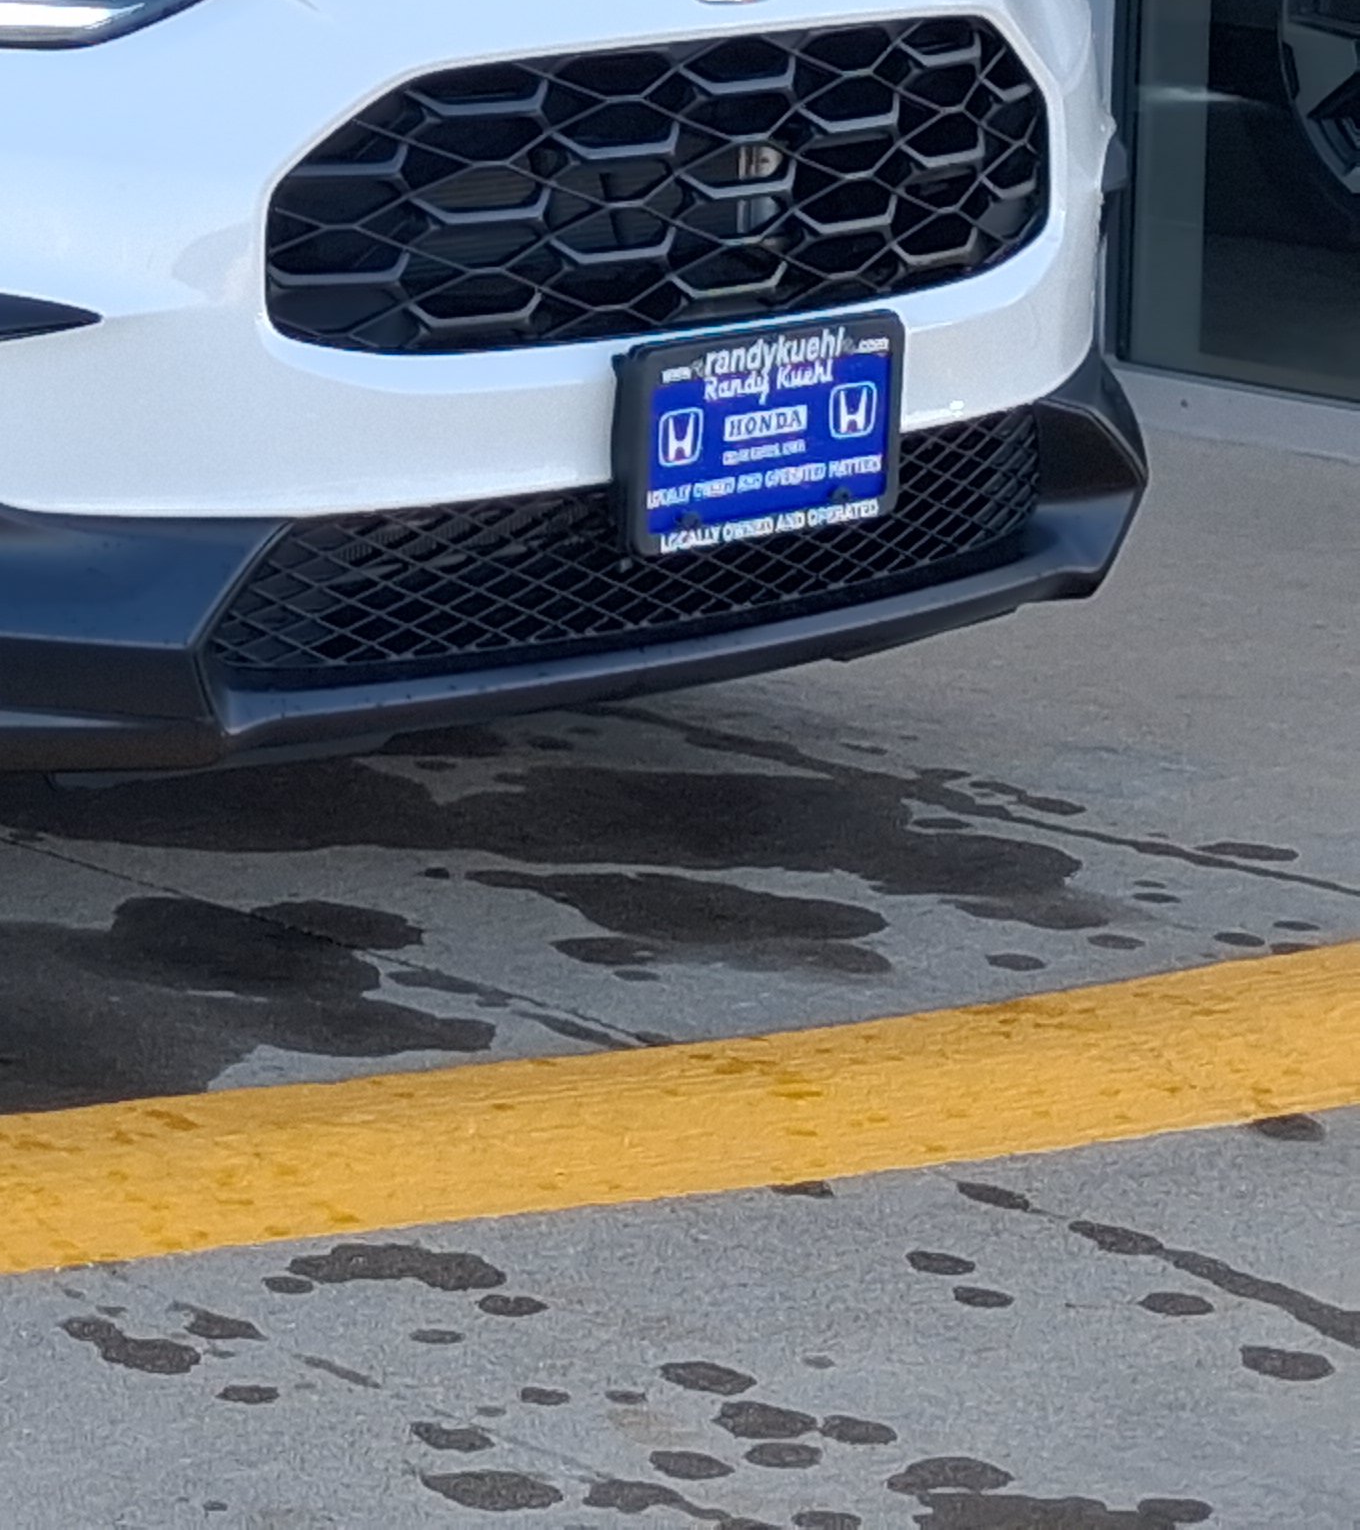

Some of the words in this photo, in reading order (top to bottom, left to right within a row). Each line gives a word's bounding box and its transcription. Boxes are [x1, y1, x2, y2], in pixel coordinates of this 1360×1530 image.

[704, 327, 846, 378] randykuehl
[702, 374, 771, 405] Randy
[776, 359, 834, 390] Kuehl
[727, 411, 804, 438] HONDA
[660, 527, 720, 553] LOCALLY
[774, 510, 806, 532] AND
[807, 498, 880, 526] OPERATED
